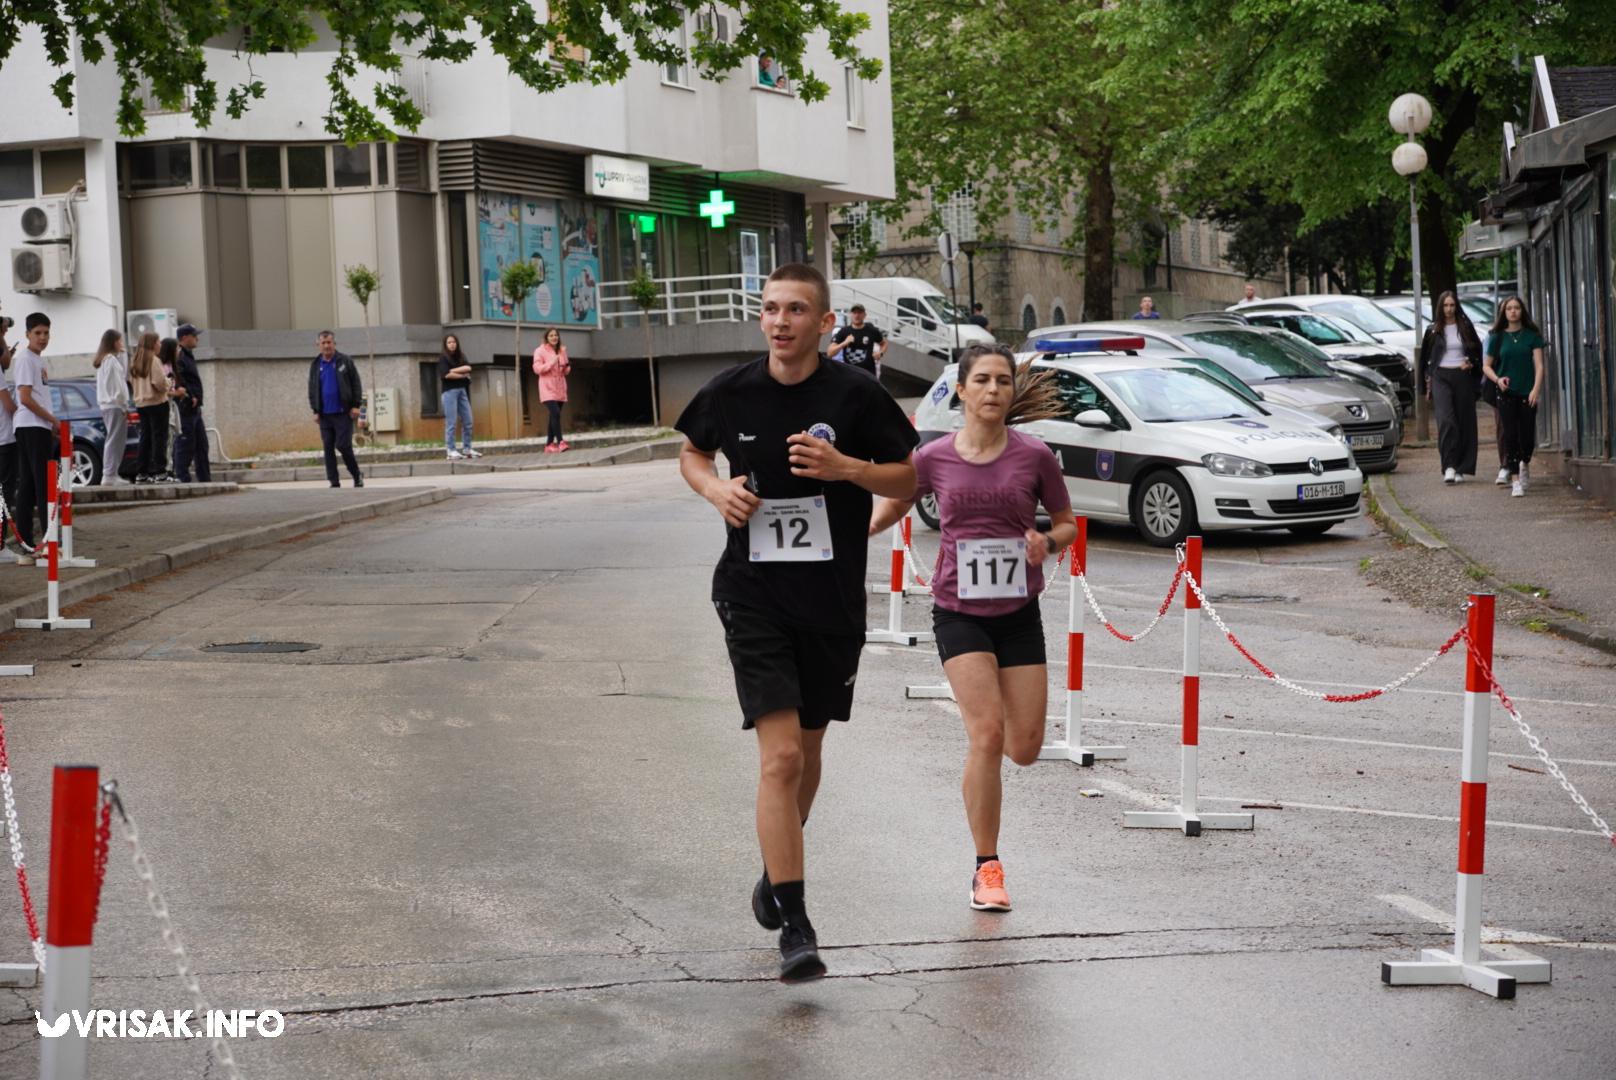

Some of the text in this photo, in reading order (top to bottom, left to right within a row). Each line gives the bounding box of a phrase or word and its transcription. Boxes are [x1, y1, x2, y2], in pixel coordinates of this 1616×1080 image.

[1234, 430, 1325, 444] POLICIJA
[948, 490, 1019, 506] STRONG
[1303, 484, 1344, 498] 016-M-118
[768, 517, 812, 549] 12
[965, 557, 1019, 586] 117
